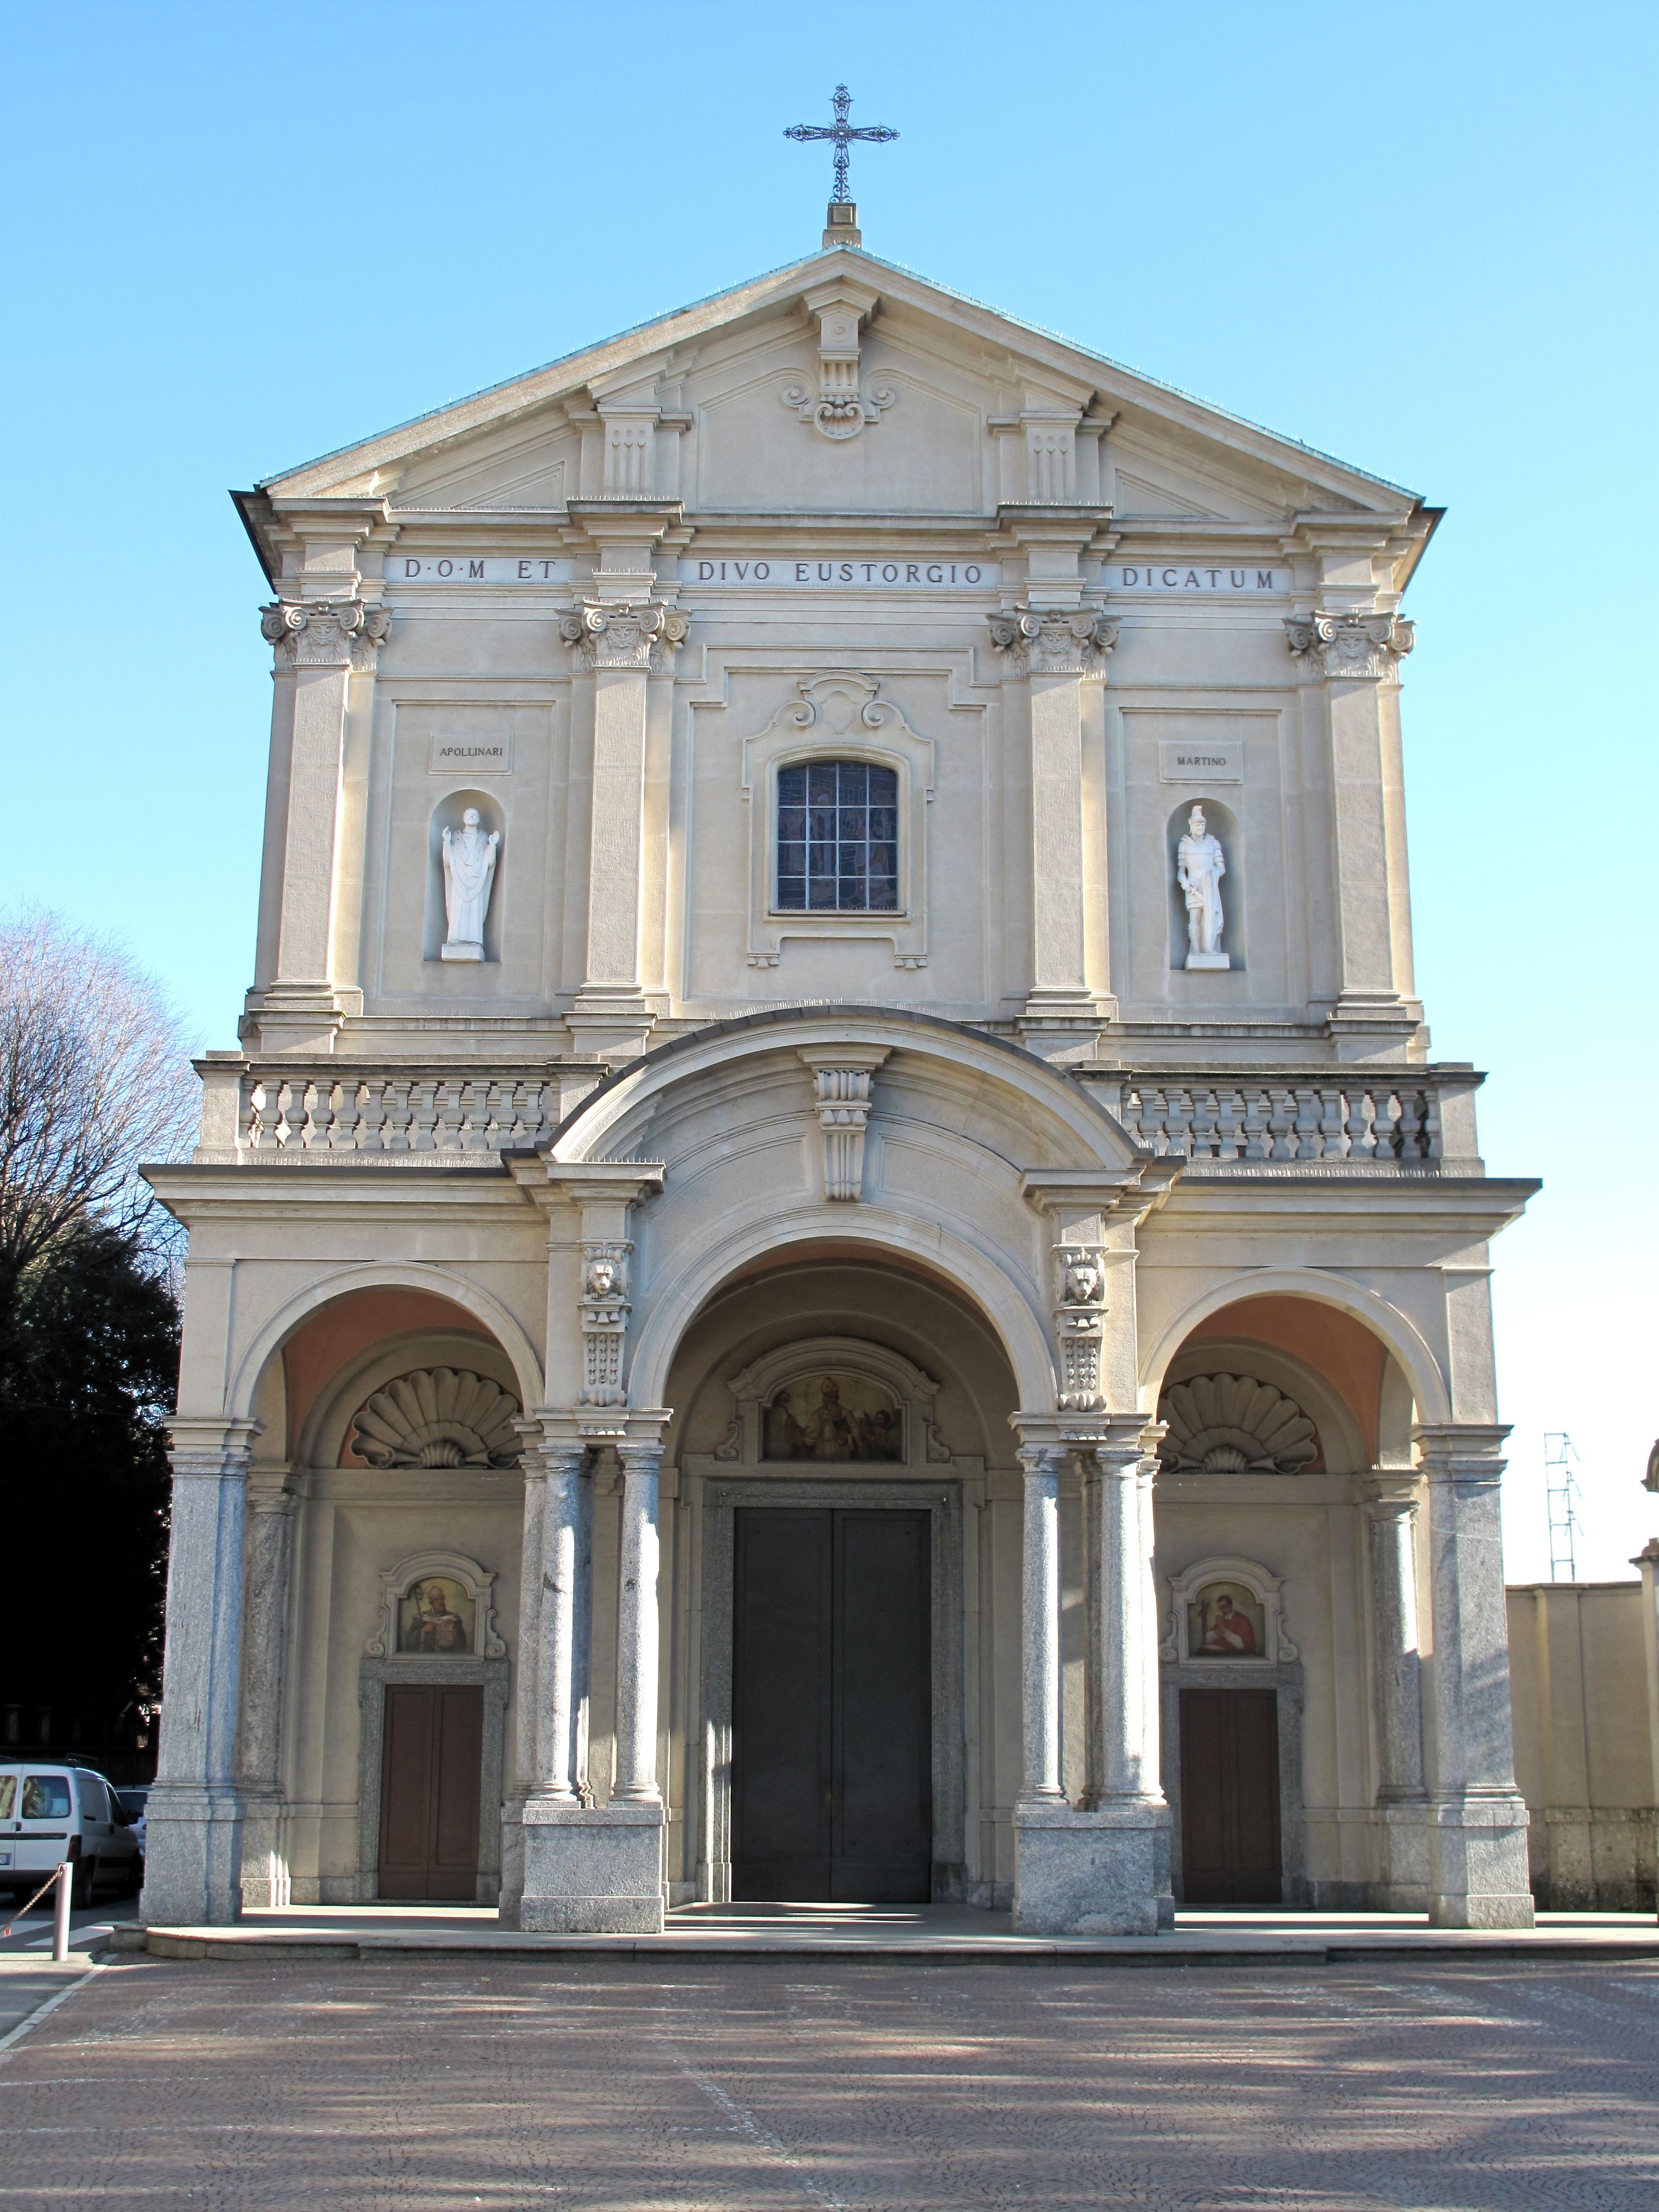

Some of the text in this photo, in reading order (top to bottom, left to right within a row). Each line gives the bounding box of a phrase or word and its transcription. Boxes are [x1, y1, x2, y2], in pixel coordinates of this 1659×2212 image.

[518, 561, 556, 579] ET
[699, 562, 770, 580] DIVO
[795, 564, 981, 584] EUSTORGIO
[1122, 568, 1273, 589] DICATUM
[440, 747, 503, 756] APOLLINARI
[1177, 757, 1226, 766] MARTINO
